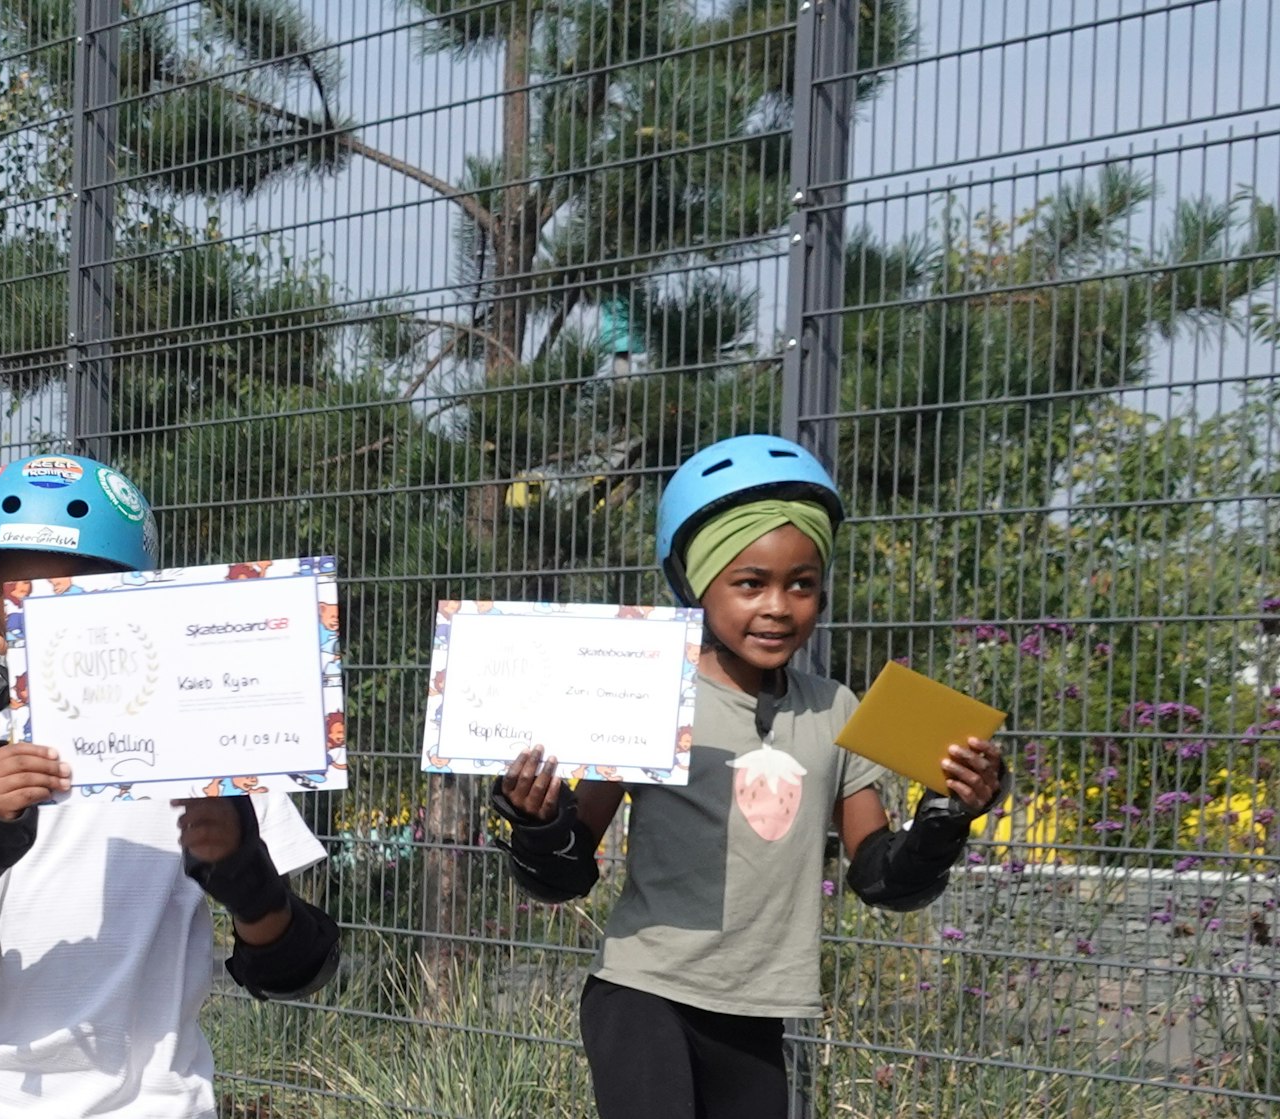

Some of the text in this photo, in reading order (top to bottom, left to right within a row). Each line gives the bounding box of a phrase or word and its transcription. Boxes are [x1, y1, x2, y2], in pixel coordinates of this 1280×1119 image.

[28, 460, 80, 469] KEEP
[185, 617, 289, 638] SkateboardGB
[61, 648, 138, 680] CRUISERS
[223, 673, 259, 692] Ryan
